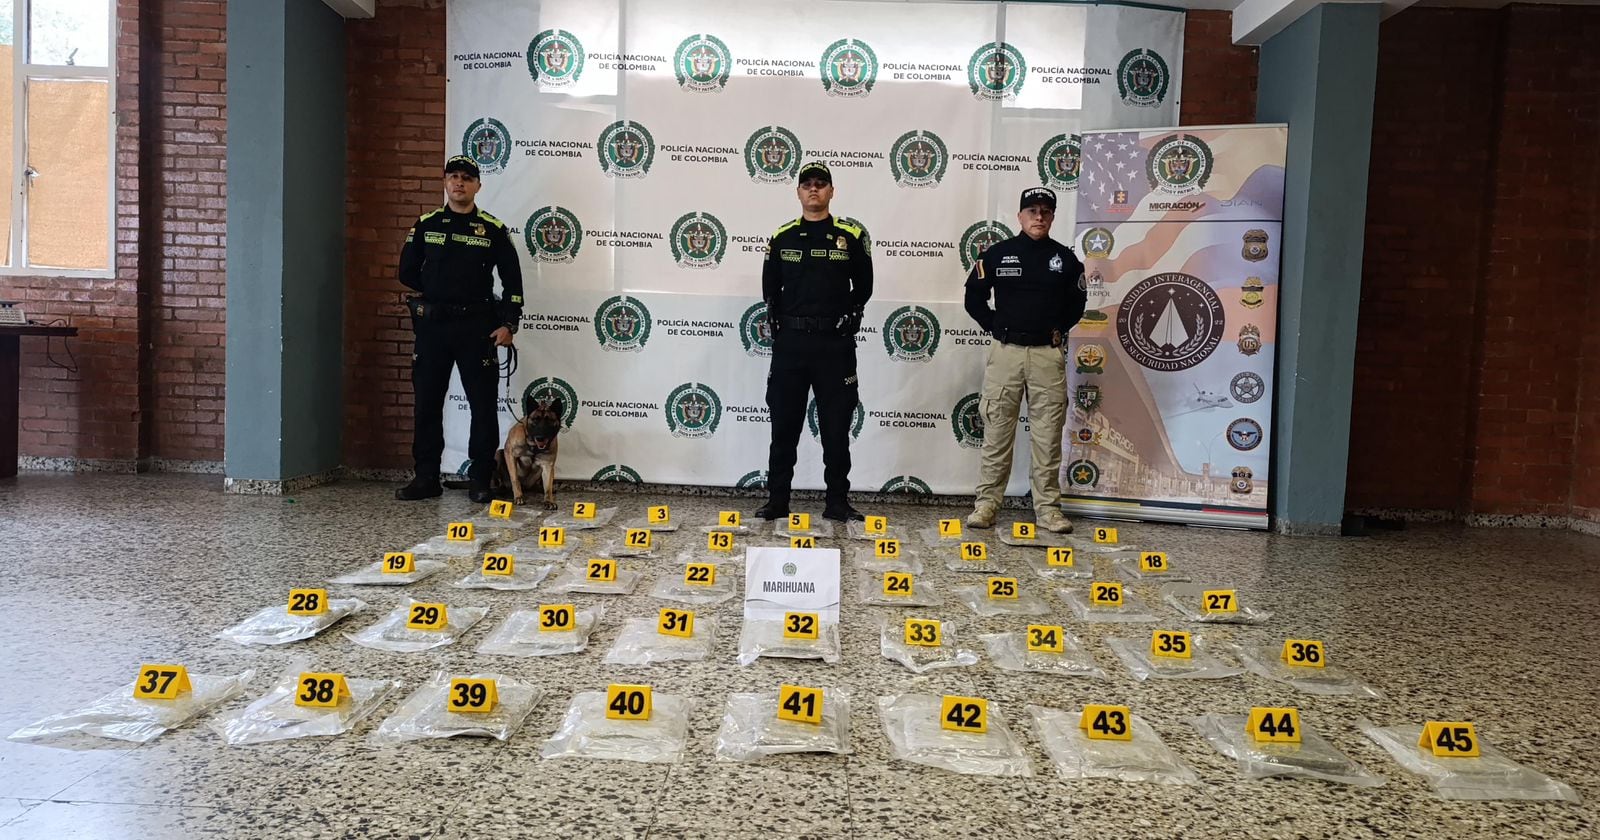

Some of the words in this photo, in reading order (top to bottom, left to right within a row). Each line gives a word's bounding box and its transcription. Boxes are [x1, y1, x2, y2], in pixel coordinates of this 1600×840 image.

[454, 53, 481, 61] POLICÍA
[483, 52, 522, 60] NACIONAL
[623, 54, 667, 62] NACIONAL
[474, 61, 512, 69] COLOMBIA
[976, 163, 1020, 171] COLOMBIA
[1122, 281, 1151, 311] UNIDAD
[1154, 274, 1220, 312] INTERAGENCIAL
[1120, 334, 1128, 347] DE
[1129, 346, 1178, 370] SEGURIDAD
[1180, 336, 1220, 368] NACIONAL
[582, 400, 614, 408] POLICÍA
[498, 504, 506, 514] 1
[577, 504, 585, 514] 2
[658, 509, 665, 518] 3
[727, 514, 736, 524] 4
[792, 515, 800, 525] 5
[874, 518, 882, 529] 6
[451, 526, 467, 537] 10
[942, 521, 950, 532] 7
[1020, 524, 1028, 535] 8
[541, 530, 558, 541] 11
[631, 532, 646, 544] 12
[712, 534, 728, 547] 13
[1098, 530, 1106, 541] 9
[794, 538, 812, 548] 14
[879, 542, 896, 553] 15
[966, 544, 981, 556] 16
[1053, 550, 1070, 562] 17
[388, 556, 405, 569] 19
[486, 557, 507, 570] 20
[1146, 556, 1162, 567] 18
[590, 564, 609, 578] 21
[688, 567, 708, 581] 22
[763, 581, 815, 593] MARIHUANA
[888, 577, 909, 592] 24
[992, 581, 1014, 596] 25
[1097, 586, 1118, 601] 26
[291, 594, 318, 610] 28
[1208, 595, 1230, 609] 27
[411, 607, 438, 624] 29
[543, 609, 568, 627] 30
[663, 612, 687, 631] 31
[788, 615, 813, 633] 32
[910, 622, 936, 642] 33
[1031, 629, 1056, 648] 34
[1159, 634, 1186, 652] 35
[1292, 643, 1319, 662] 36
[141, 670, 177, 693] 37
[301, 678, 334, 702] 38
[453, 684, 486, 707] 39
[610, 692, 644, 714] 40
[784, 692, 814, 716] 41
[947, 704, 981, 728] 42
[1093, 711, 1126, 735] 43
[1260, 713, 1295, 737] 44
[1436, 728, 1472, 752] 45
